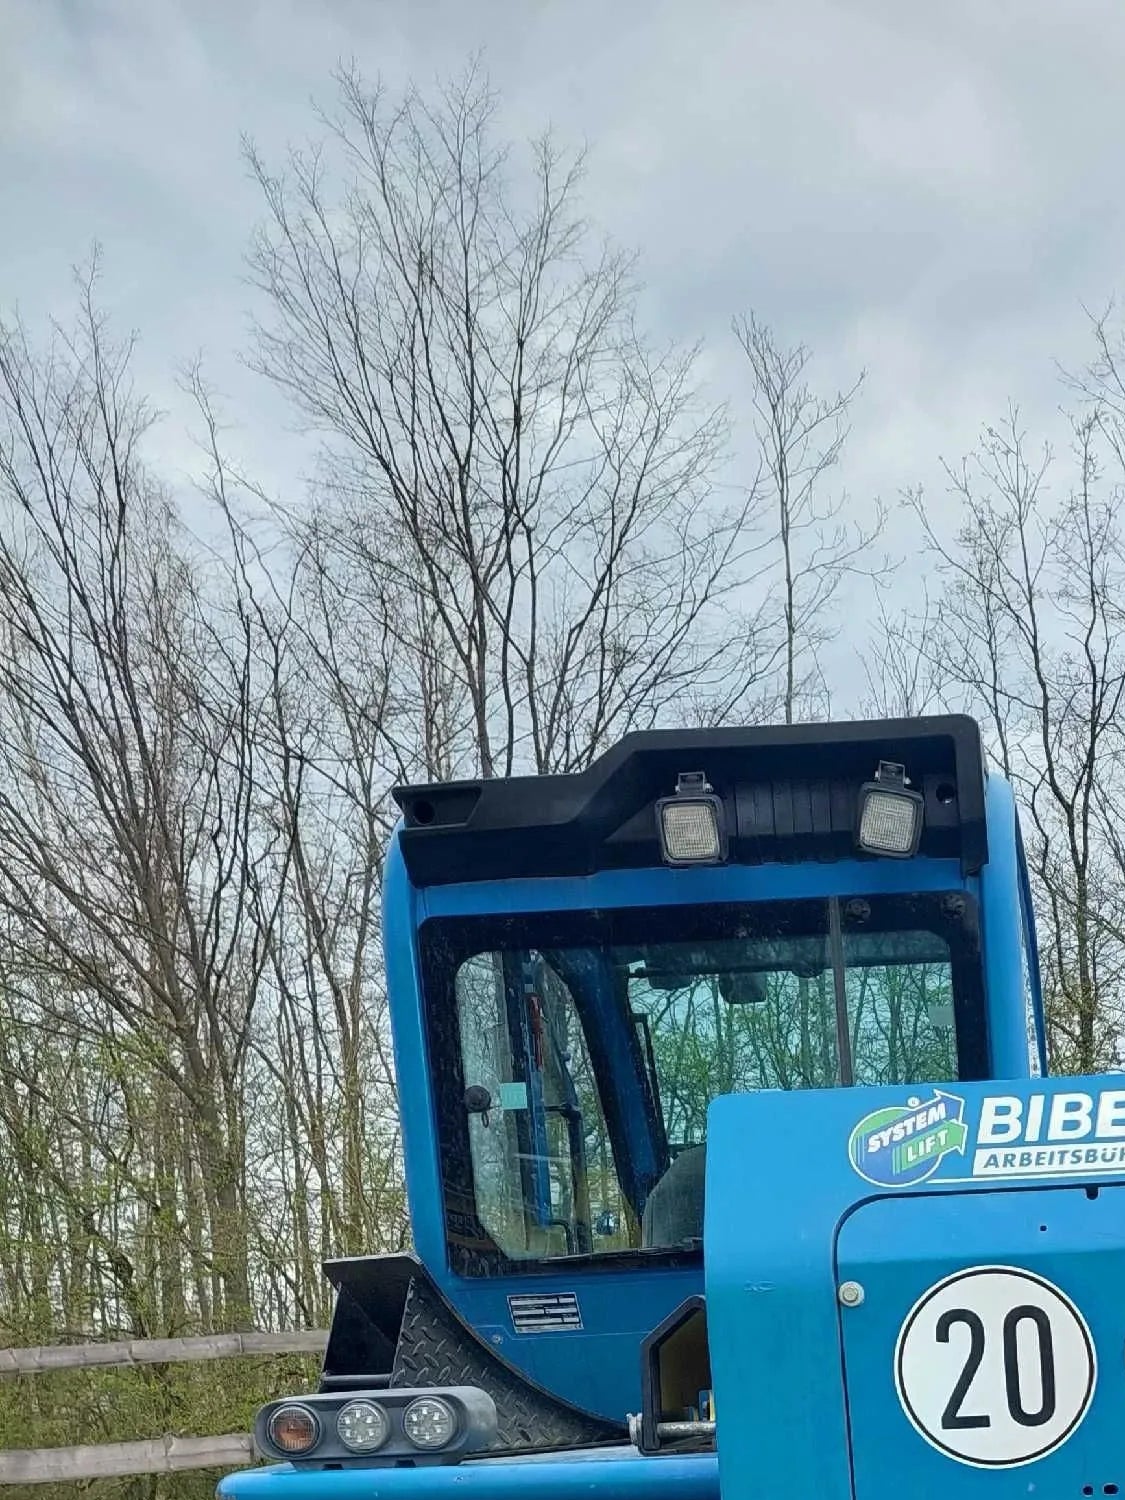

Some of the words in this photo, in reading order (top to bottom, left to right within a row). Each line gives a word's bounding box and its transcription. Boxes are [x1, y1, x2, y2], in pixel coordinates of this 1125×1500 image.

[867, 1102, 947, 1153] SYSTEM
[907, 1128, 949, 1162] LIFT
[935, 1304, 1056, 1430] 20
